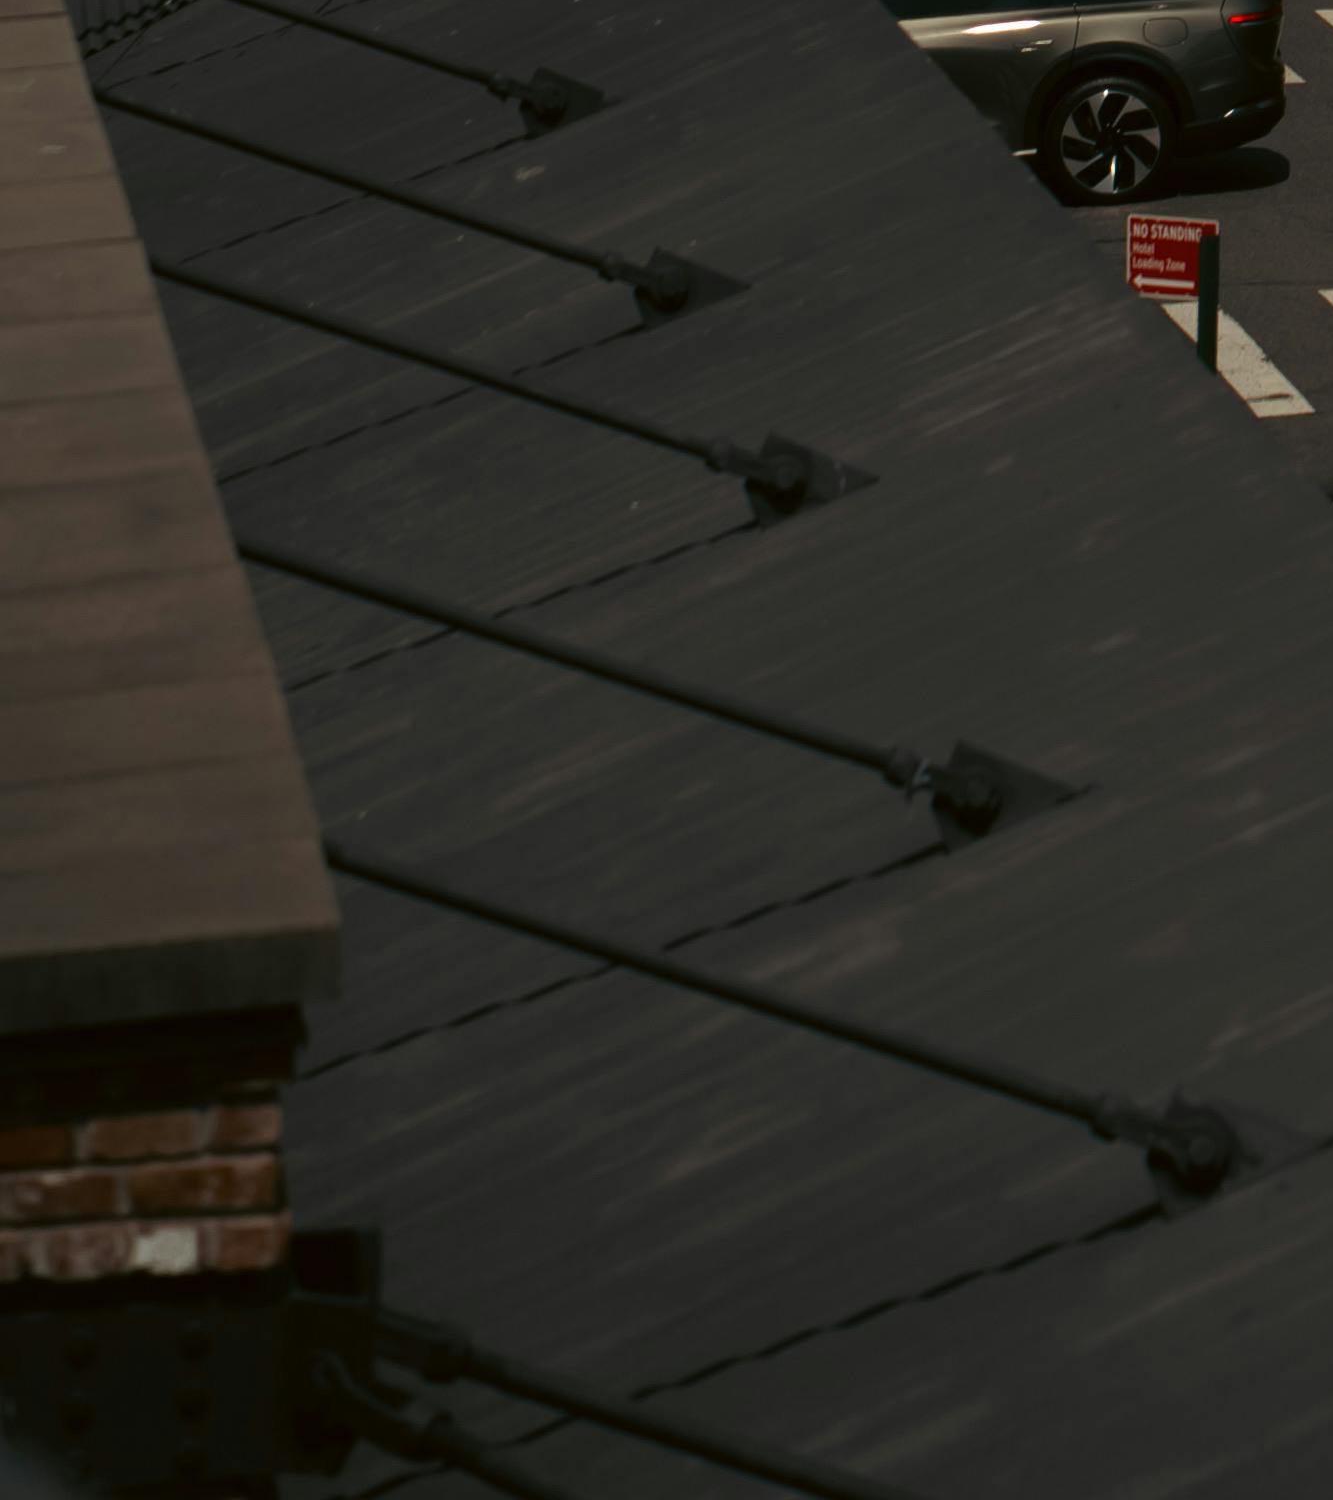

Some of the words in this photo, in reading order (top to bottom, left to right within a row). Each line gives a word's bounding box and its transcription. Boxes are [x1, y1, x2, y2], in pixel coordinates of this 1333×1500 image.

[1133, 222, 1149, 238] NO
[1132, 241, 1155, 255] Hotel
[1132, 256, 1165, 273] Loading
[1165, 257, 1186, 273] Zone
